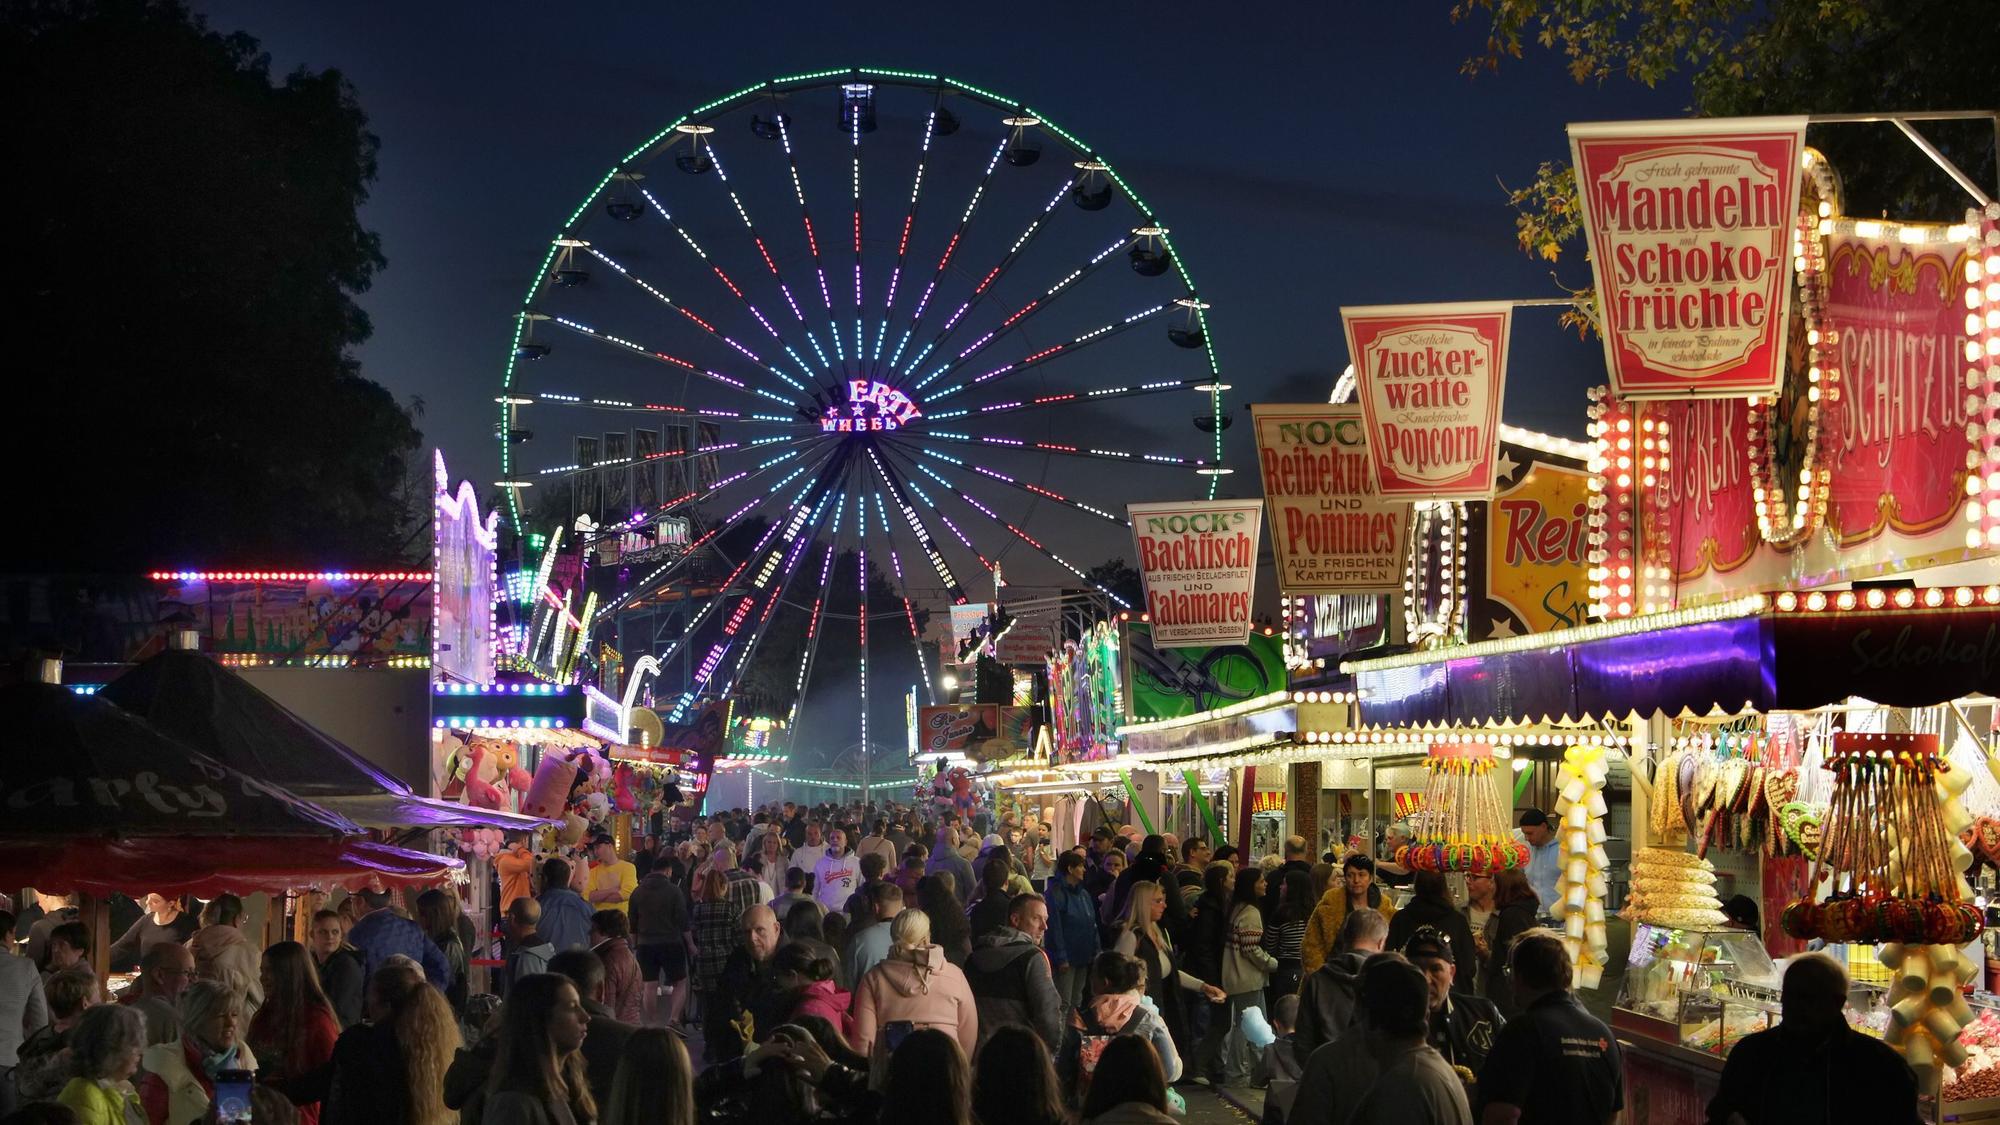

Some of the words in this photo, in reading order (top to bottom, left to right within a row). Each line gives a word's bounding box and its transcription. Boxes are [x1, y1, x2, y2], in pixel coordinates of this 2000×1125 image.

[1684, 162, 1740, 181] gebrannte
[1599, 177, 1779, 231] Mandeln
[1679, 236, 1697, 247] und
[1616, 241, 1779, 286] Schoko-
[1618, 286, 1766, 331] früchte
[1398, 333, 1454, 345] Köstliche
[1648, 339, 1658, 349] in
[1658, 337, 1692, 353] feinster
[1376, 346, 1484, 379] Zucker-
[1385, 377, 1470, 410] watte
[821, 417, 897, 431] WHEEL
[1279, 420, 1366, 446] NOC
[1382, 422, 1480, 473] Popcorn
[1262, 446, 1375, 496] Reibekuc
[1320, 499, 1363, 510] UND
[1284, 506, 1397, 555] Pommes
[1500, 499, 1594, 564] Rei
[1138, 532, 1250, 572] Backfisch
[1288, 559, 1317, 569] AUS
[1324, 558, 1395, 568] FRISCHEN
[1148, 573, 1161, 582] AUS
[1163, 573, 1195, 581] FRISCHEM
[1184, 583, 1213, 591] UND
[1295, 570, 1388, 581] KARTOFFELN
[1148, 589, 1249, 626] Calamares
